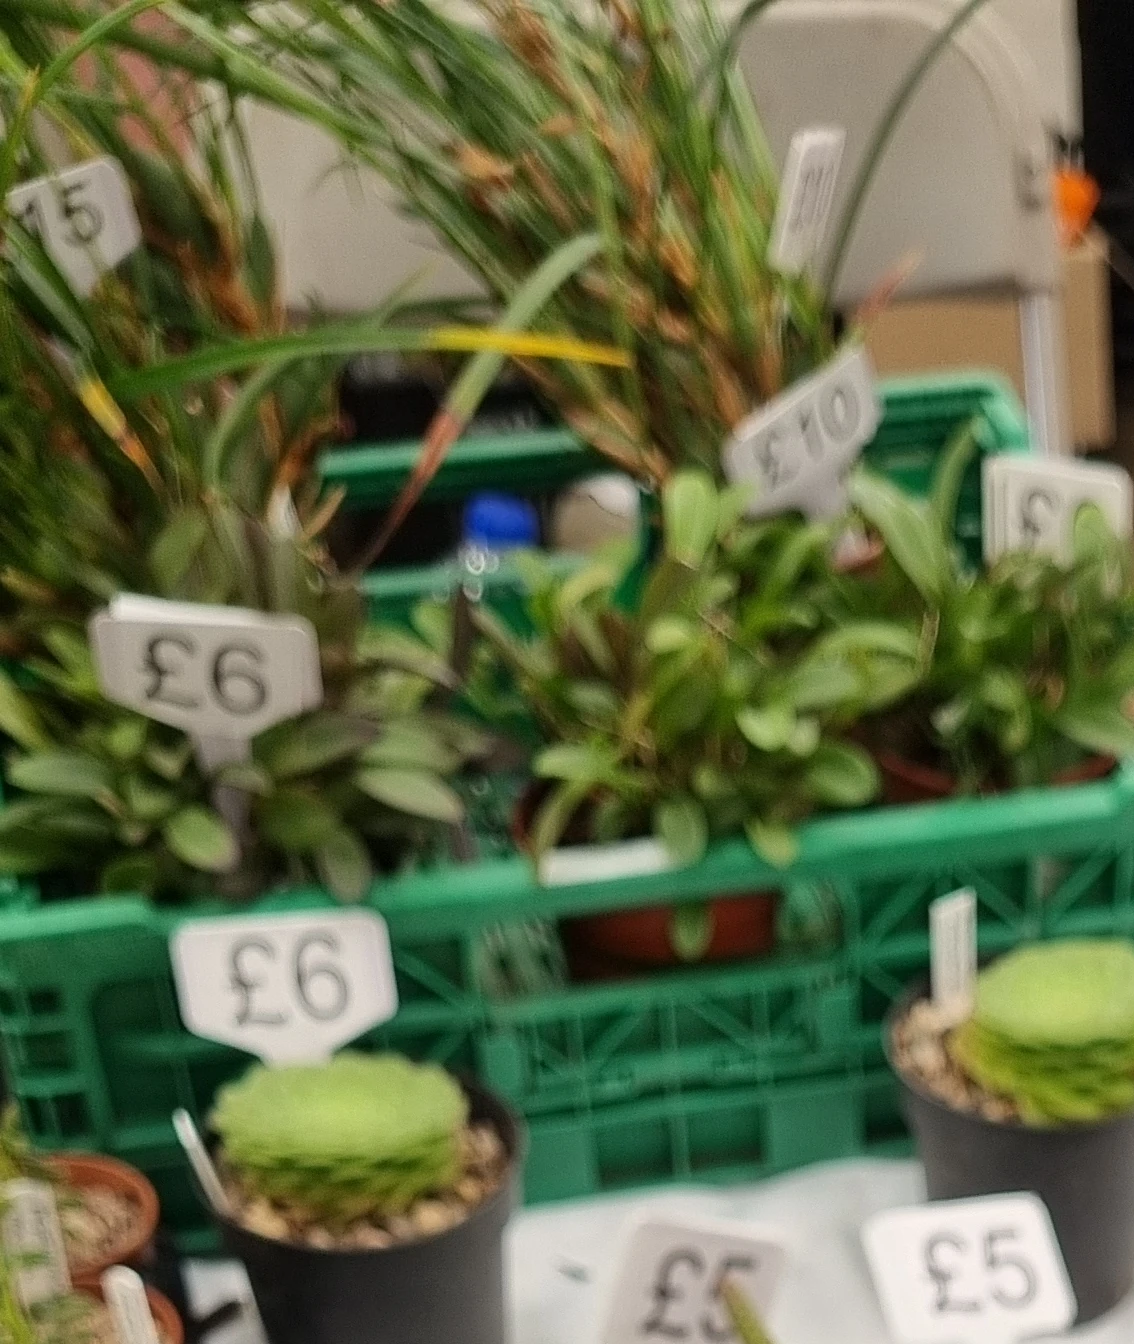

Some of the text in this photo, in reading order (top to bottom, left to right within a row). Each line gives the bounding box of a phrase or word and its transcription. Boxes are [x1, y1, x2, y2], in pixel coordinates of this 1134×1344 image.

[141, 631, 268, 709] £6
[232, 930, 350, 1027] £6
[641, 1246, 760, 1343] £5
[924, 1228, 1038, 1314] £5
